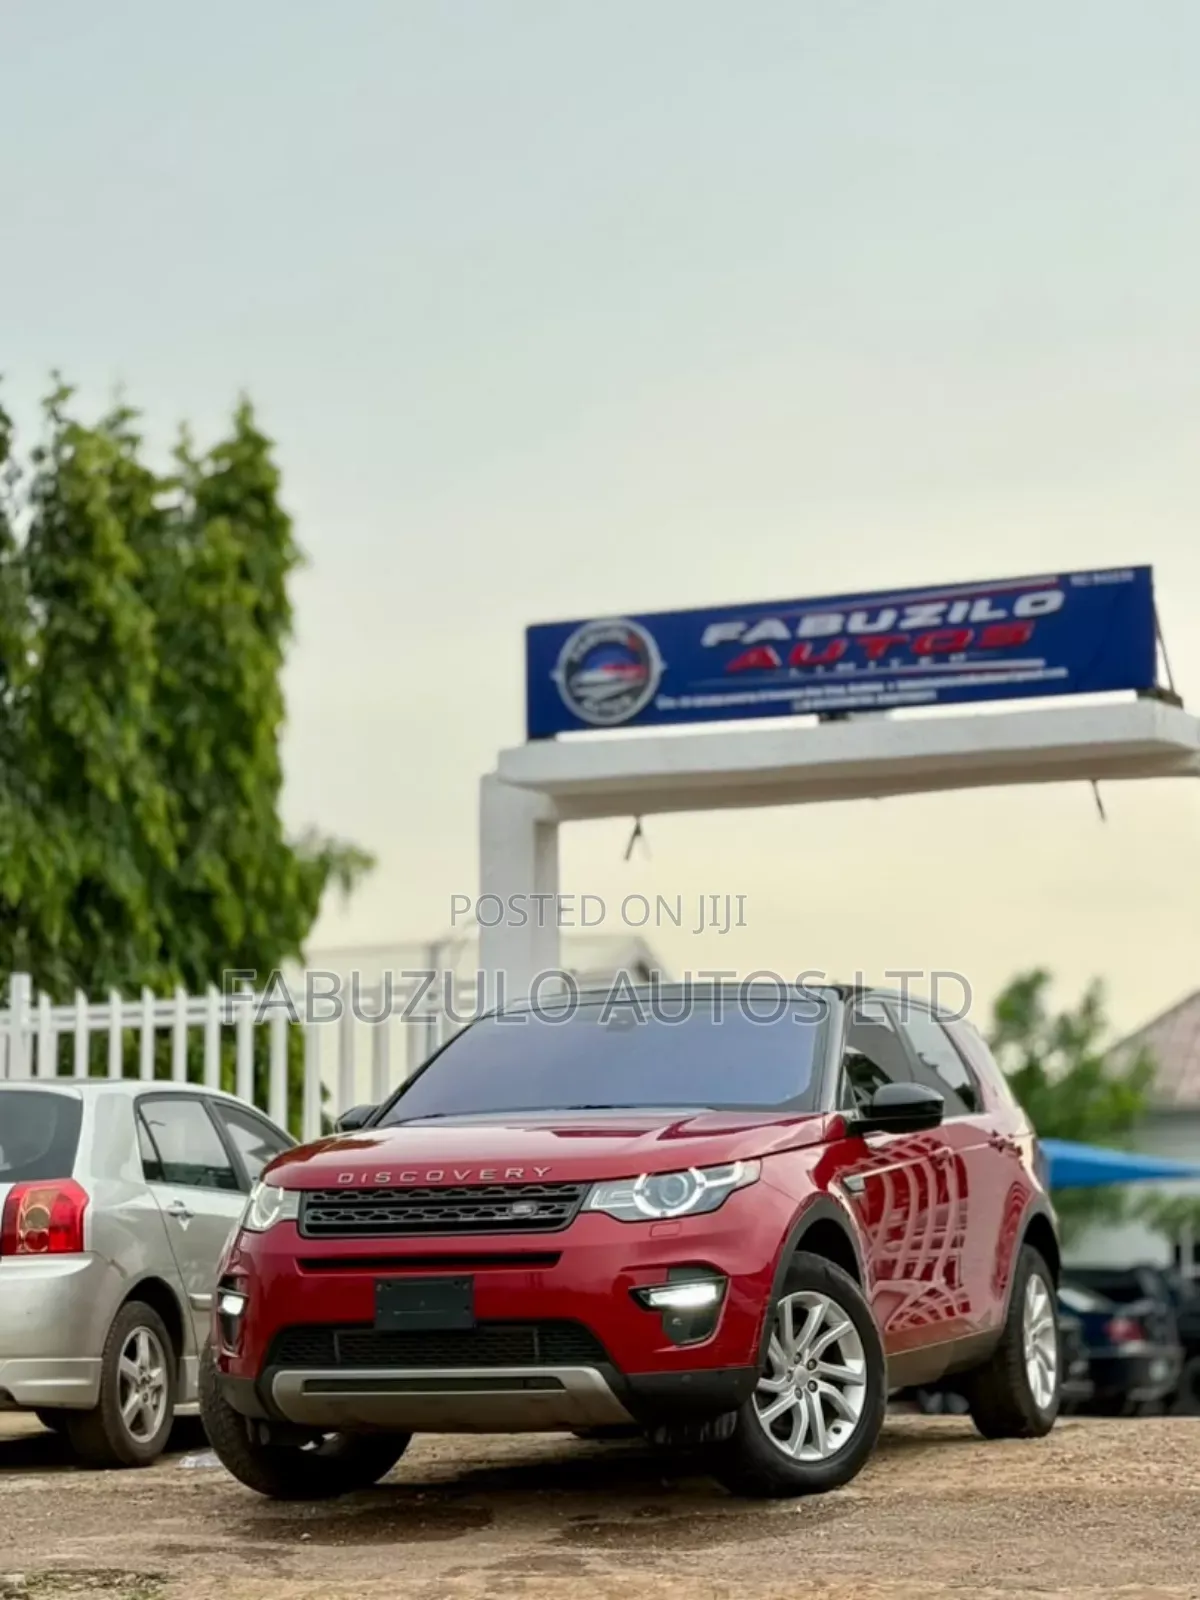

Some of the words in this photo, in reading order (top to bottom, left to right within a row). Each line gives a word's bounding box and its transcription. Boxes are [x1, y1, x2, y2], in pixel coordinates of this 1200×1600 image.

[701, 590, 1065, 647] FABUZILO
[726, 621, 1035, 672] AUTOS
[337, 1166, 552, 1184] DISCOVERY
